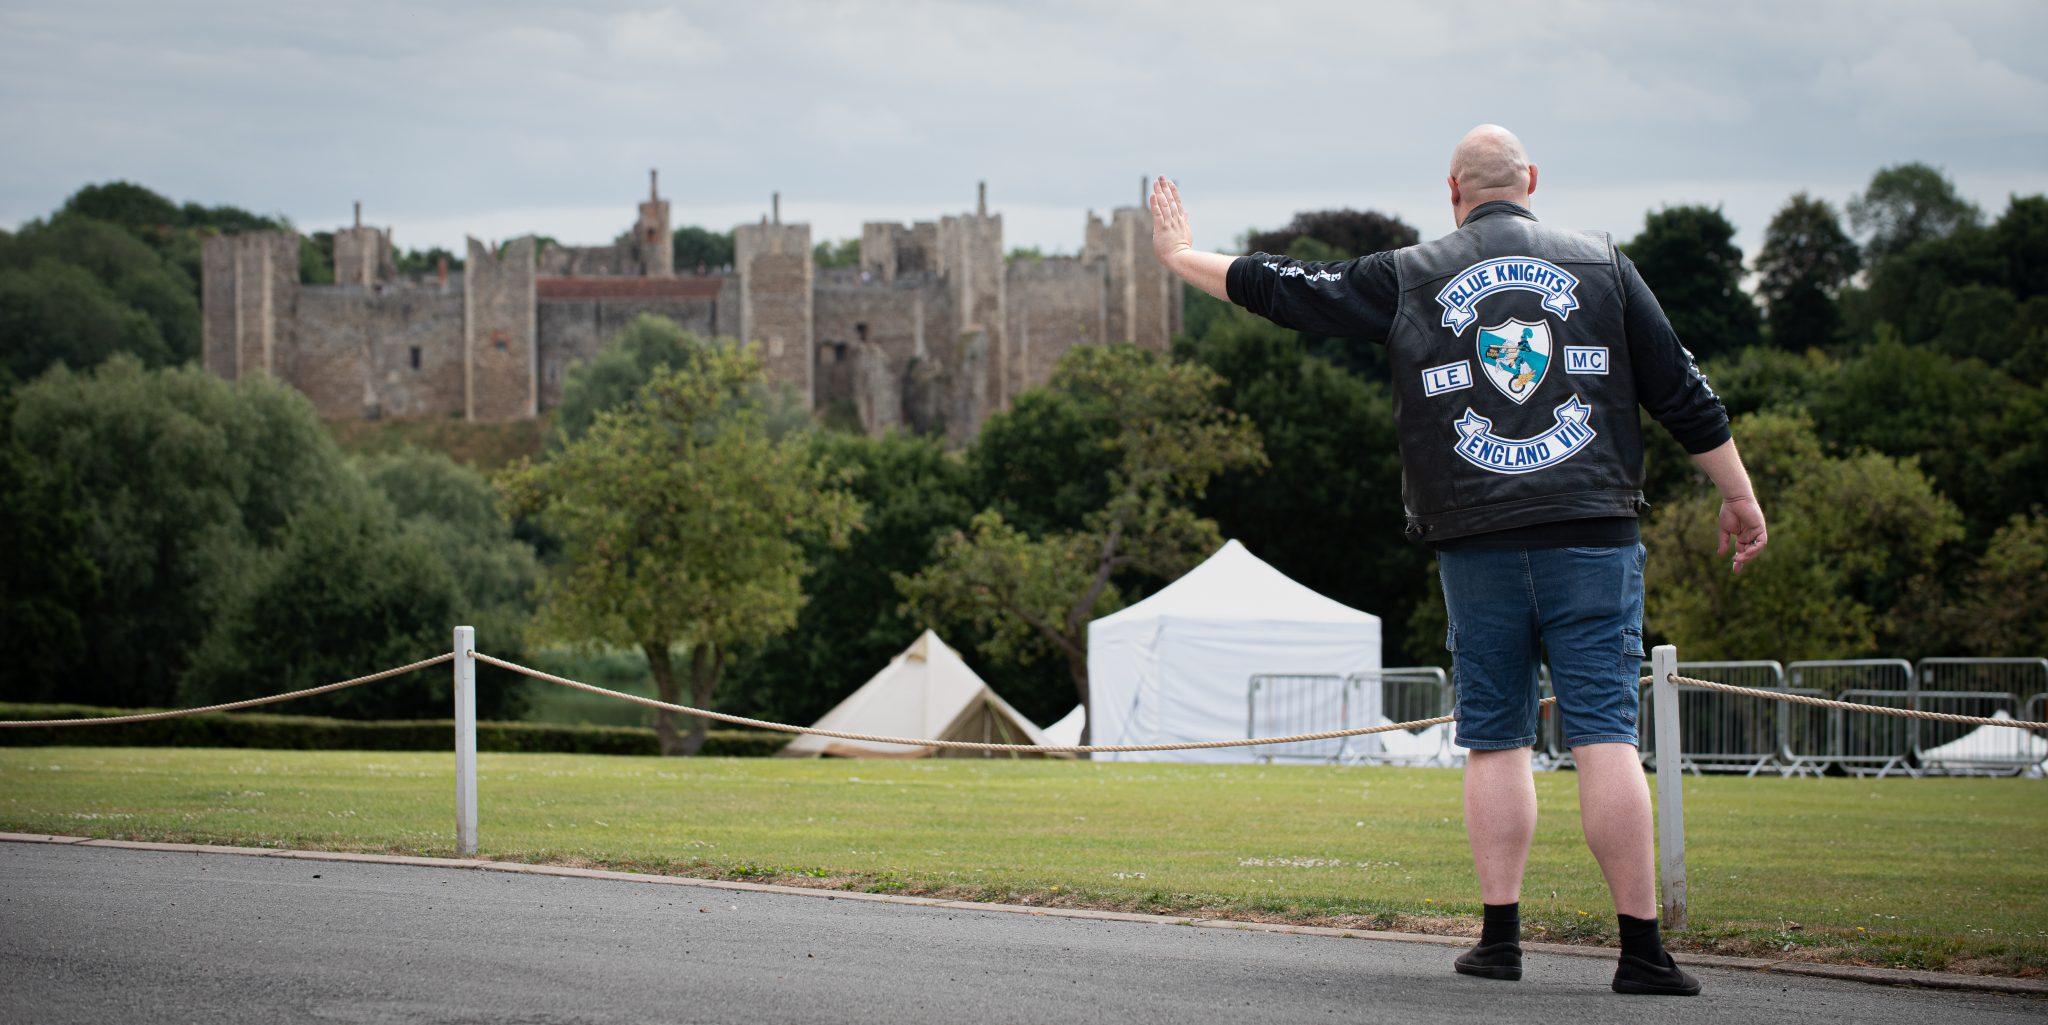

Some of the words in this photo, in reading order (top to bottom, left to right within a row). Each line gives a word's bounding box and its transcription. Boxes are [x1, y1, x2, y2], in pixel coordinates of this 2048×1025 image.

[1448, 269, 1492, 307] BLUE
[1495, 264, 1567, 293] KNIGHTS
[1573, 352, 1602, 368] MC
[1433, 368, 1461, 389] LE
[1466, 433, 1551, 466] ENGLAND
[1555, 422, 1585, 448] VII
